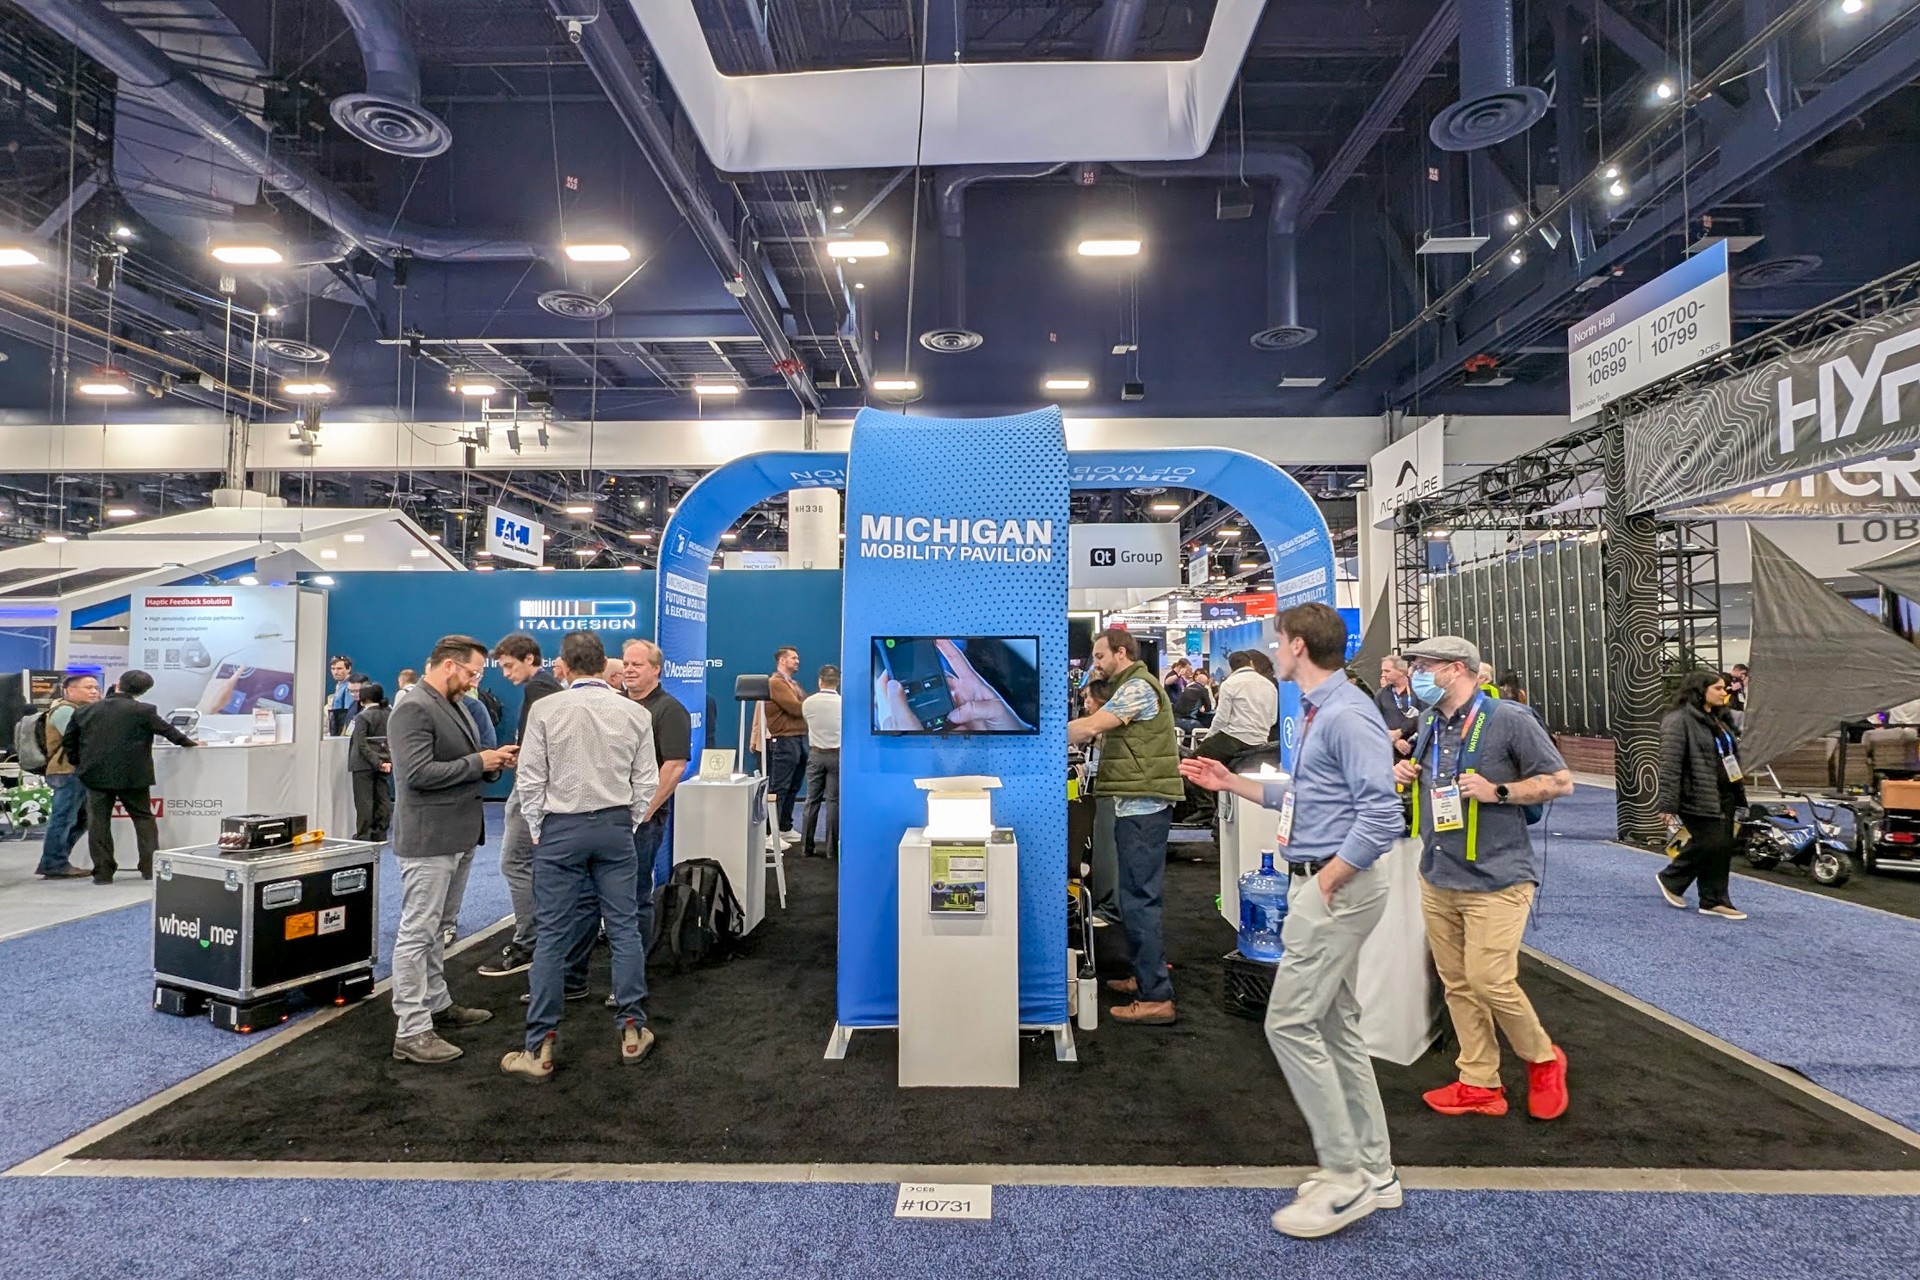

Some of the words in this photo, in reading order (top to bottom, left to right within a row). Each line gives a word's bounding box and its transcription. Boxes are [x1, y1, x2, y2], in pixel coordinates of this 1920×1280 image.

[1574, 324, 1597, 344] North
[1599, 313, 1615, 330] Hall
[1650, 301, 1705, 337] 10700-
[1586, 337, 1633, 368] 10500-
[1651, 323, 1697, 357] 10799
[1705, 342, 1721, 354] CES
[1588, 356, 1626, 386] 10699
[1397, 475, 1438, 507] FUTURE
[861, 514, 1052, 545] MICHIGAN
[860, 543, 956, 561] MOBILITY
[960, 547, 1052, 563] PAVILION
[1093, 551, 1112, 565] Qt
[1120, 551, 1163, 567] Group
[147, 598, 168, 606] Haptic
[519, 619, 636, 631] ITALDESIGN
[670, 661, 704, 678] Accelerator
[1468, 711, 1487, 753] WATERPROOF
[167, 799, 223, 808] SENSOR
[159, 913, 200, 940] wheel
[901, 1200, 971, 1212] #10731
